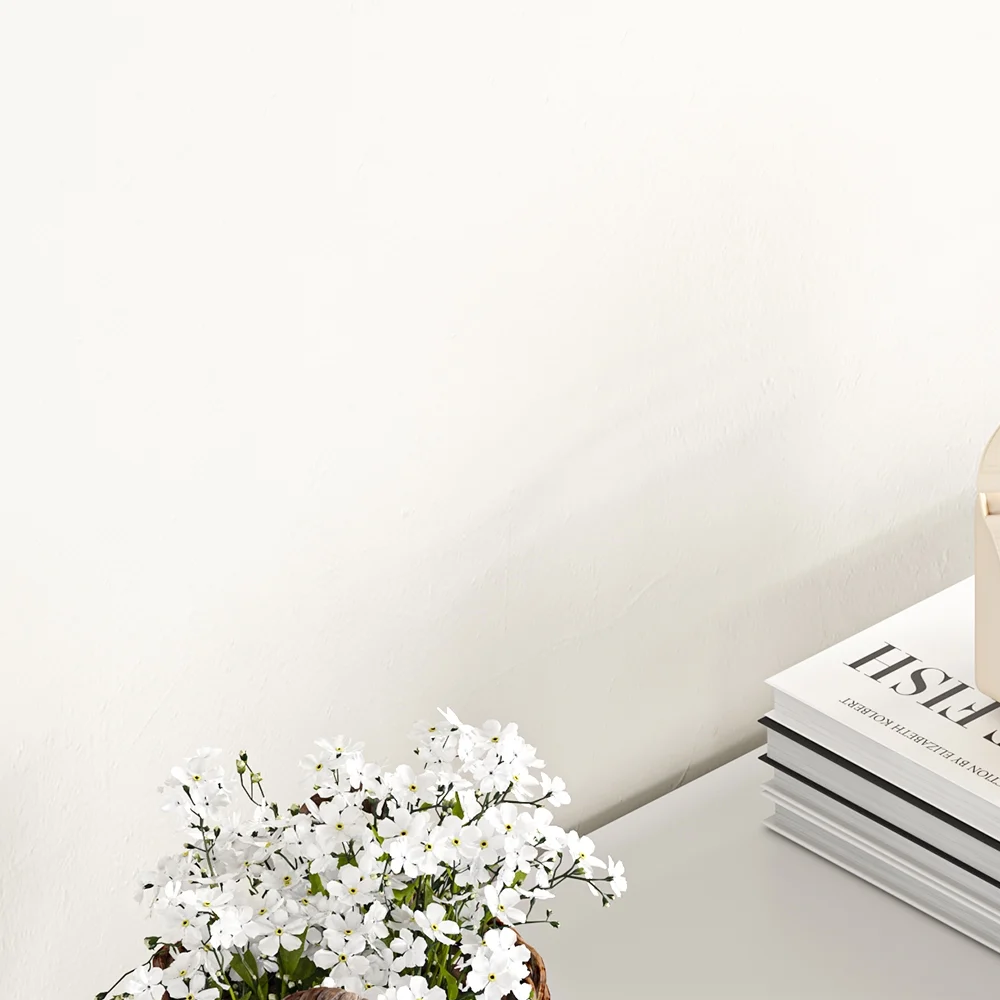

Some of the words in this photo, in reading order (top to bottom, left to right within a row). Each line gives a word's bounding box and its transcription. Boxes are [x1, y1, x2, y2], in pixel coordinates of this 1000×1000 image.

[838, 696, 894, 728] KOLBERT
[892, 723, 955, 760] ELIZABETH
[951, 756, 971, 768] BY
